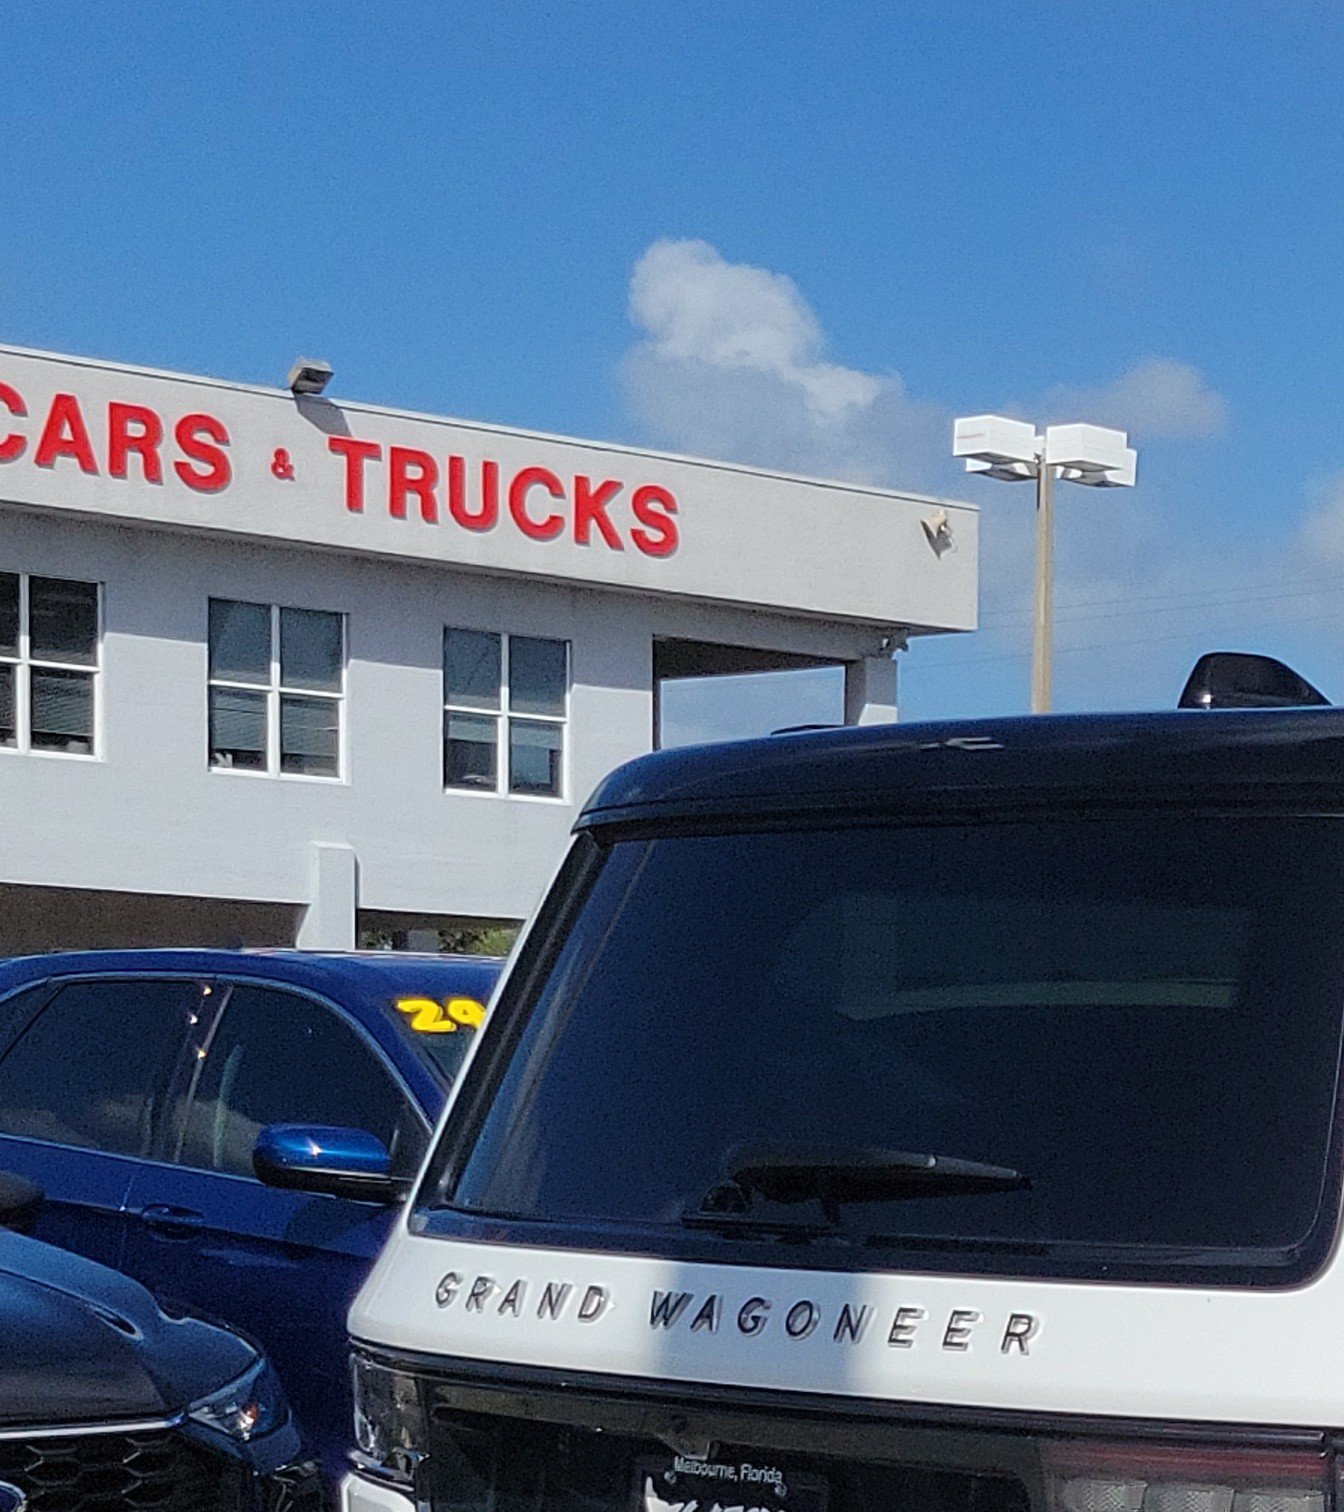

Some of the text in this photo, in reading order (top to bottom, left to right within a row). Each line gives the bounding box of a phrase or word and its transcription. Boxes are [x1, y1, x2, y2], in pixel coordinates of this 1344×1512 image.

[271, 448, 295, 481] &
[328, 435, 680, 558] TRUCKS
[435, 1271, 1040, 1356] GRAND WAGONEER
[740, 1463, 783, 1484] Florida
